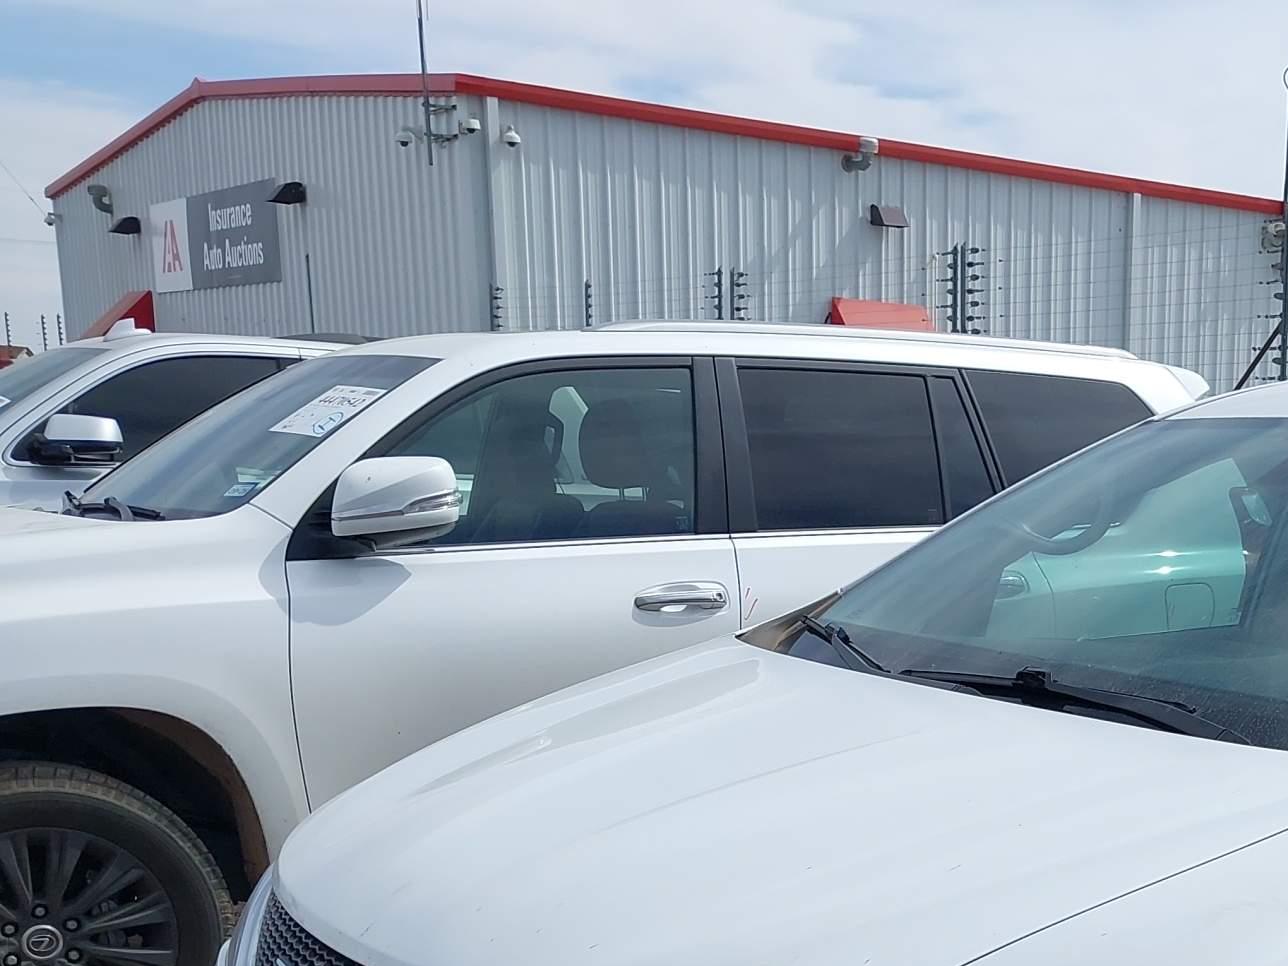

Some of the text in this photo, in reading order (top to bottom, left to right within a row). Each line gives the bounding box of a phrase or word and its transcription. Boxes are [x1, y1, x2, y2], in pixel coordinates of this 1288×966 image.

[208, 202, 252, 233] Insurance
[203, 235, 264, 271] Auto Auctions
